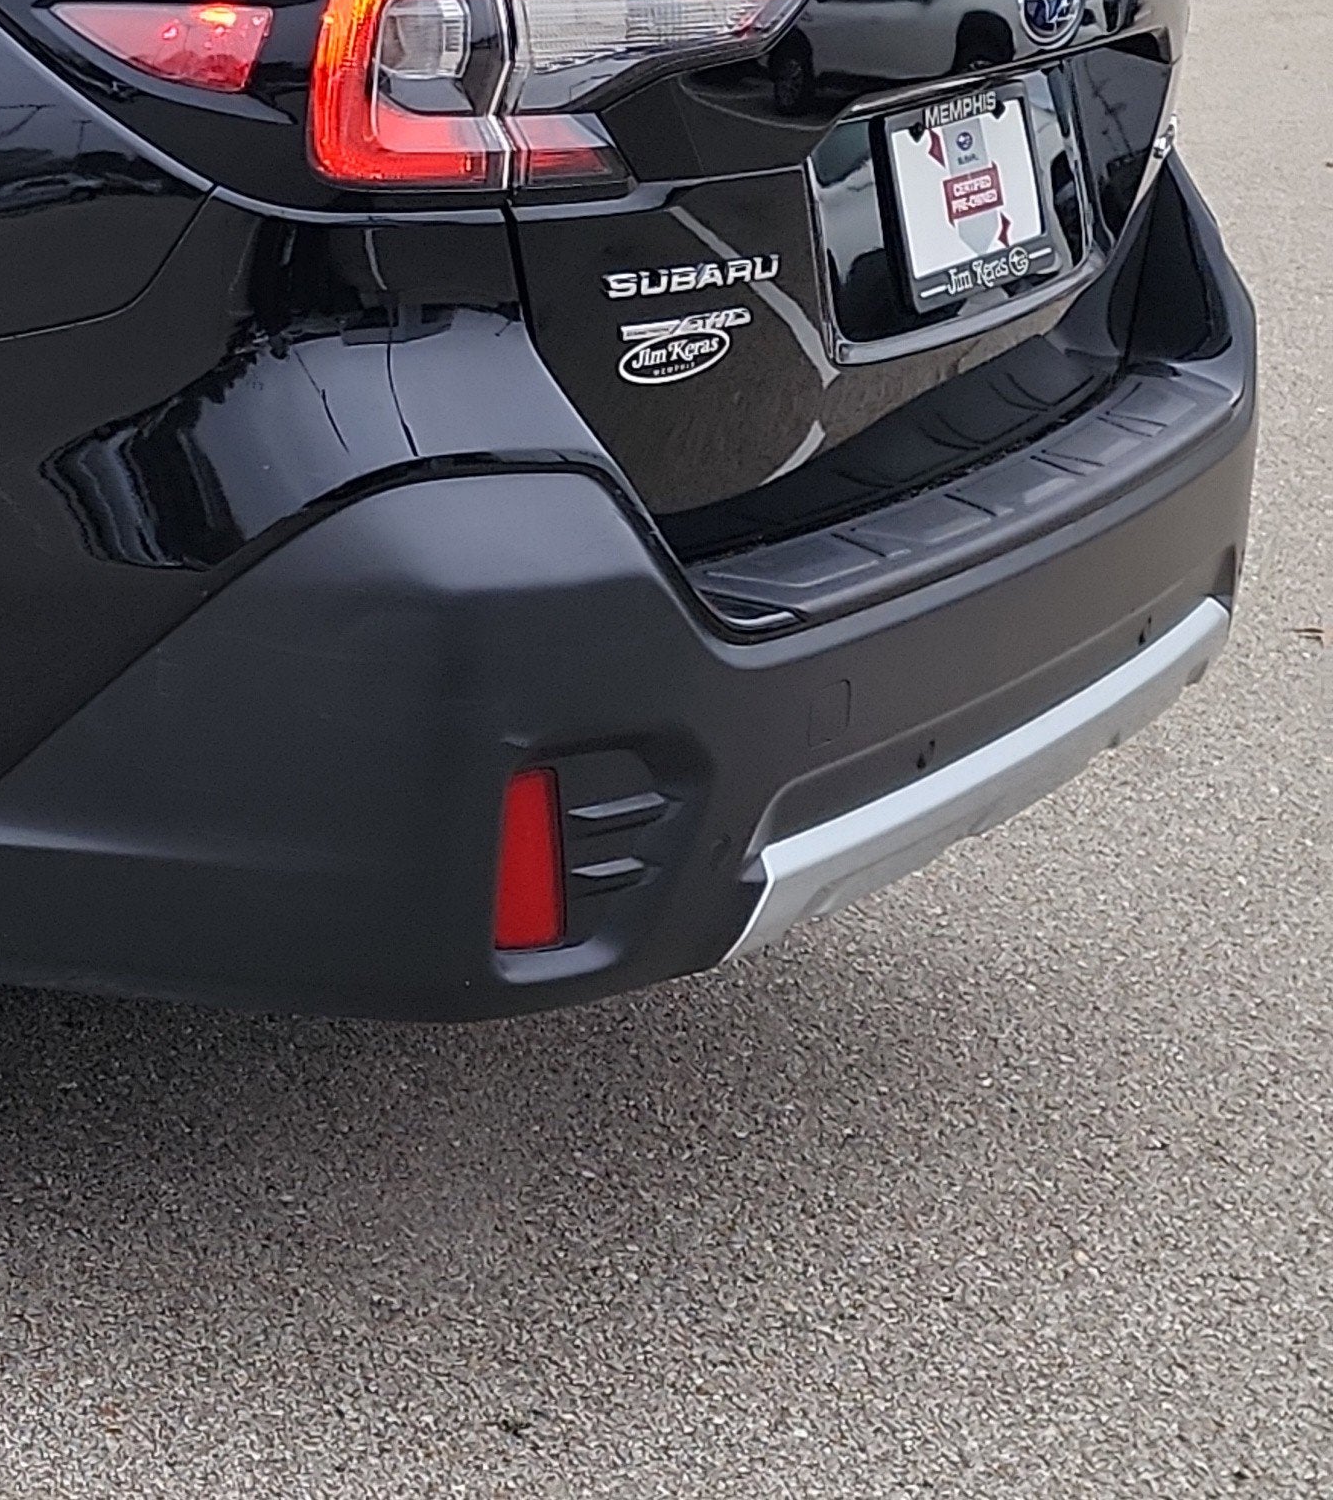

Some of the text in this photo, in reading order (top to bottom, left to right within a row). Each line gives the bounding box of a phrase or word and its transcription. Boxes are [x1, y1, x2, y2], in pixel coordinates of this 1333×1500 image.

[925, 91, 997, 128] MEMPHIS
[603, 254, 779, 298] SUBARU
[947, 268, 973, 295] Jim
[631, 337, 720, 369] Jim Keras
